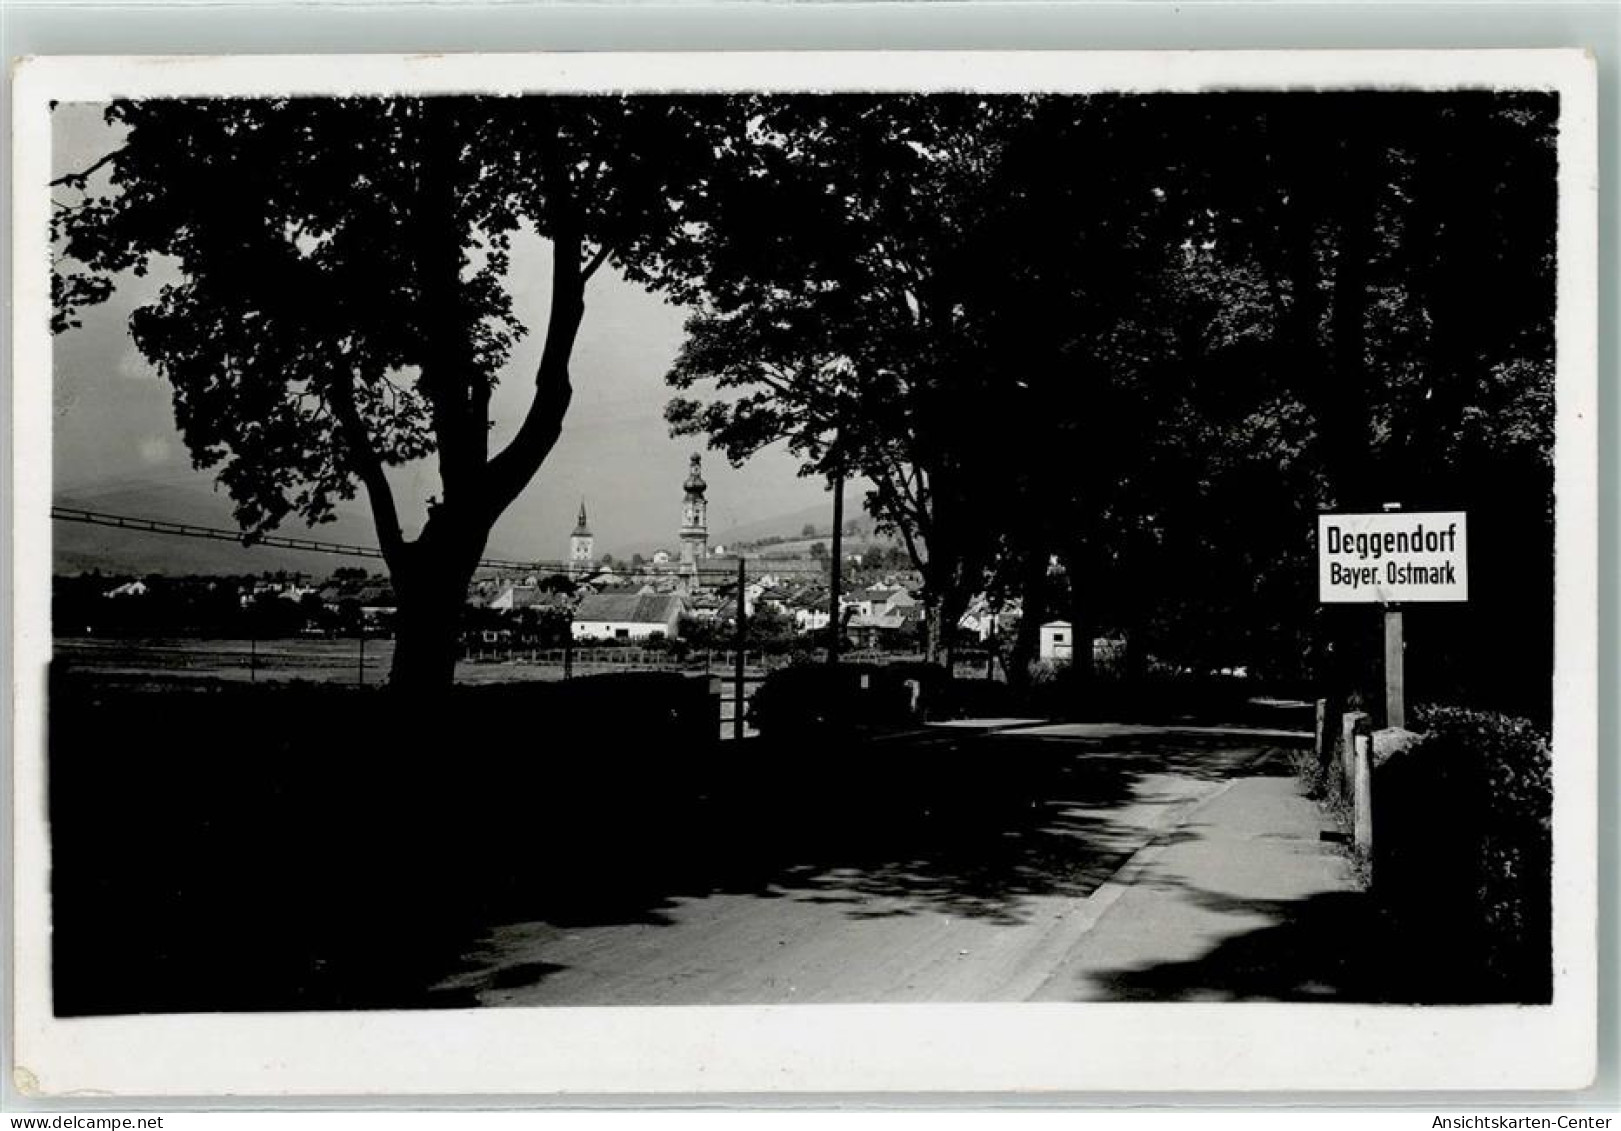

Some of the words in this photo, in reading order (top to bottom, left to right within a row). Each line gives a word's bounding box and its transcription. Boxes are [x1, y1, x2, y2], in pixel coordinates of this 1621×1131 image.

[1327, 523, 1456, 560] Deggendorf
[1330, 562, 1382, 589] Bayer.
[1387, 560, 1457, 585] Ostmark
